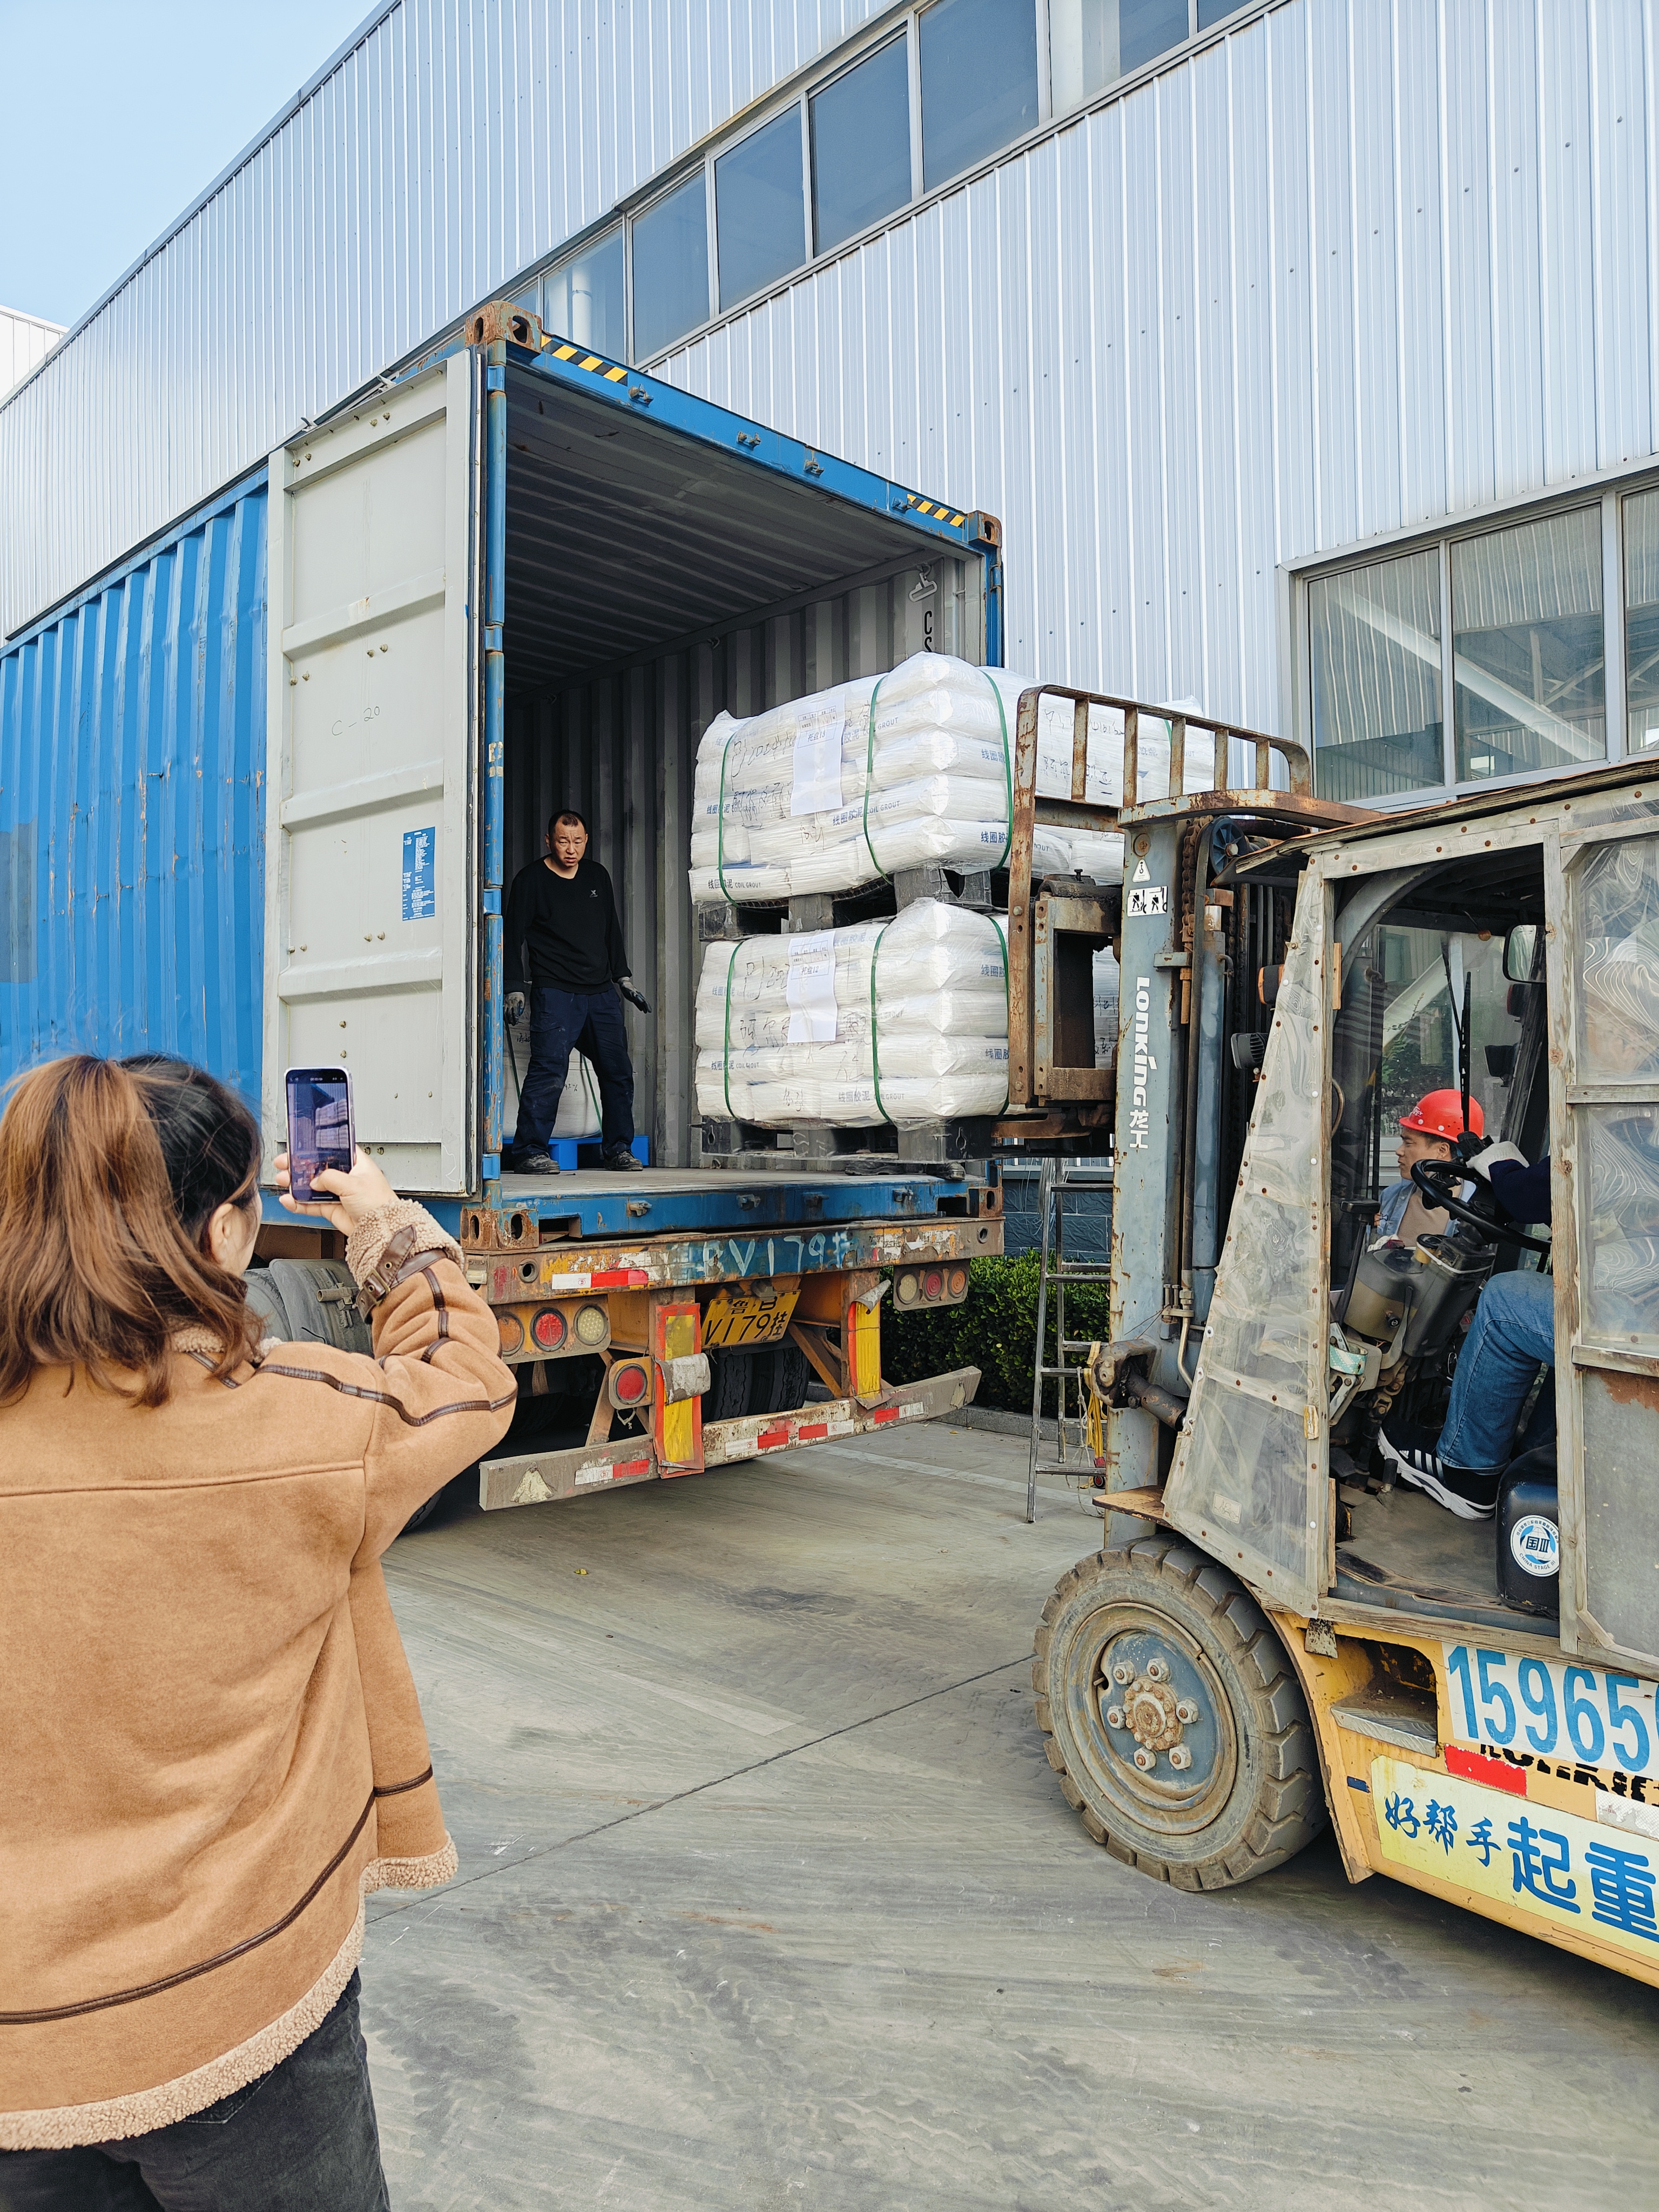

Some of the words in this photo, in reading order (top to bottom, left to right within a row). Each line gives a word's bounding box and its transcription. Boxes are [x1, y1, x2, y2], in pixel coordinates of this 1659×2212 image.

[878, 717, 899, 730] GROUT
[706, 804, 730, 814] 线圈泥
[833, 806, 863, 826] 线圈胶泥
[880, 800, 900, 811] GROUT
[1129, 1109, 1150, 1149] 龙工
[1519, 1553, 1532, 1567] CHINA
[1448, 1646, 1659, 1772] 15965
